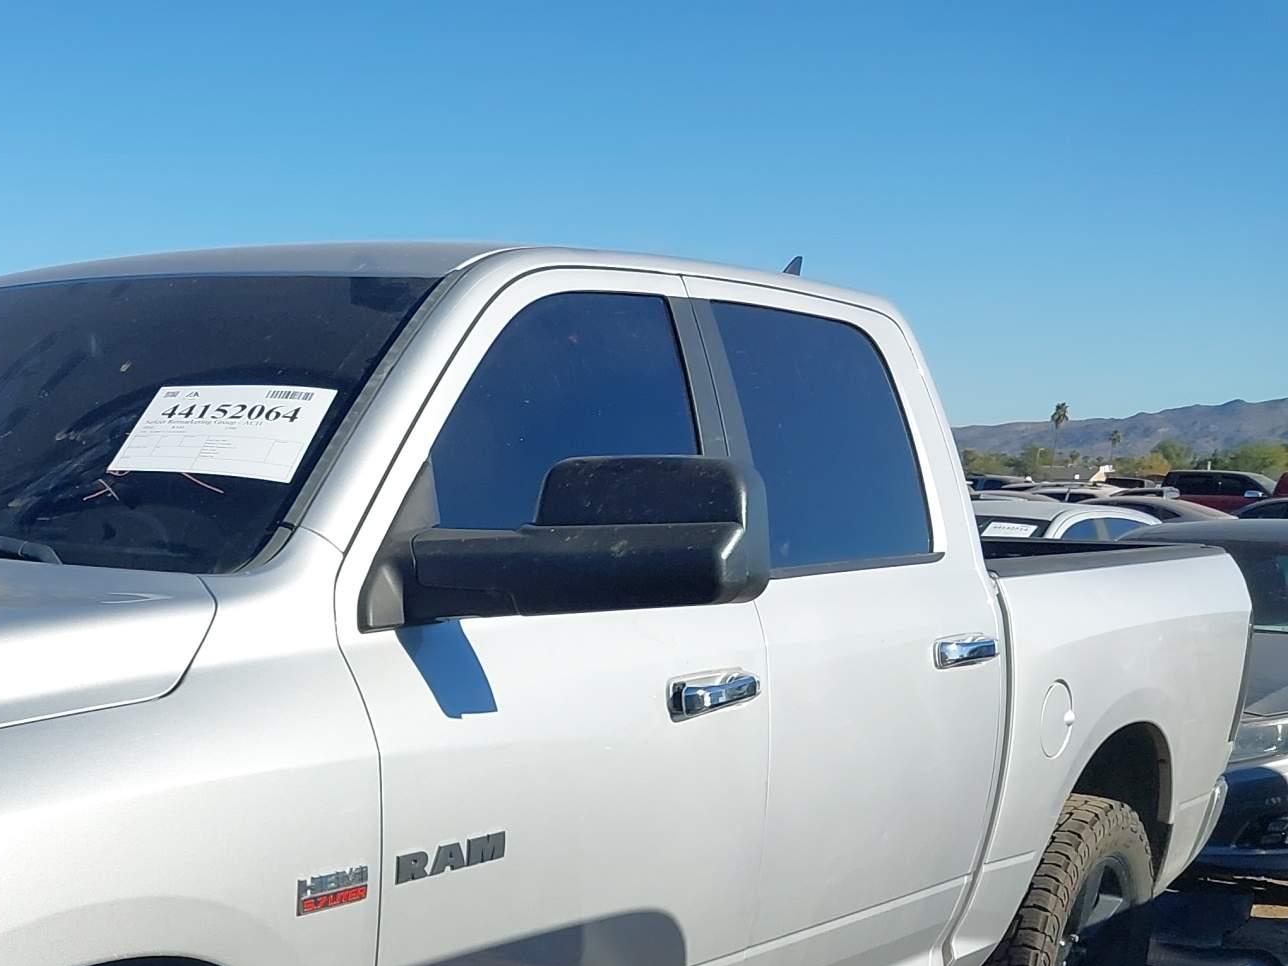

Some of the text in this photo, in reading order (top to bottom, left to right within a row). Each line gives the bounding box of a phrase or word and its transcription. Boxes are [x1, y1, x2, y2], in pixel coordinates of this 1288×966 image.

[161, 403, 302, 423] 44152064
[395, 831, 505, 885] RAM
[297, 865, 369, 899] HEMI
